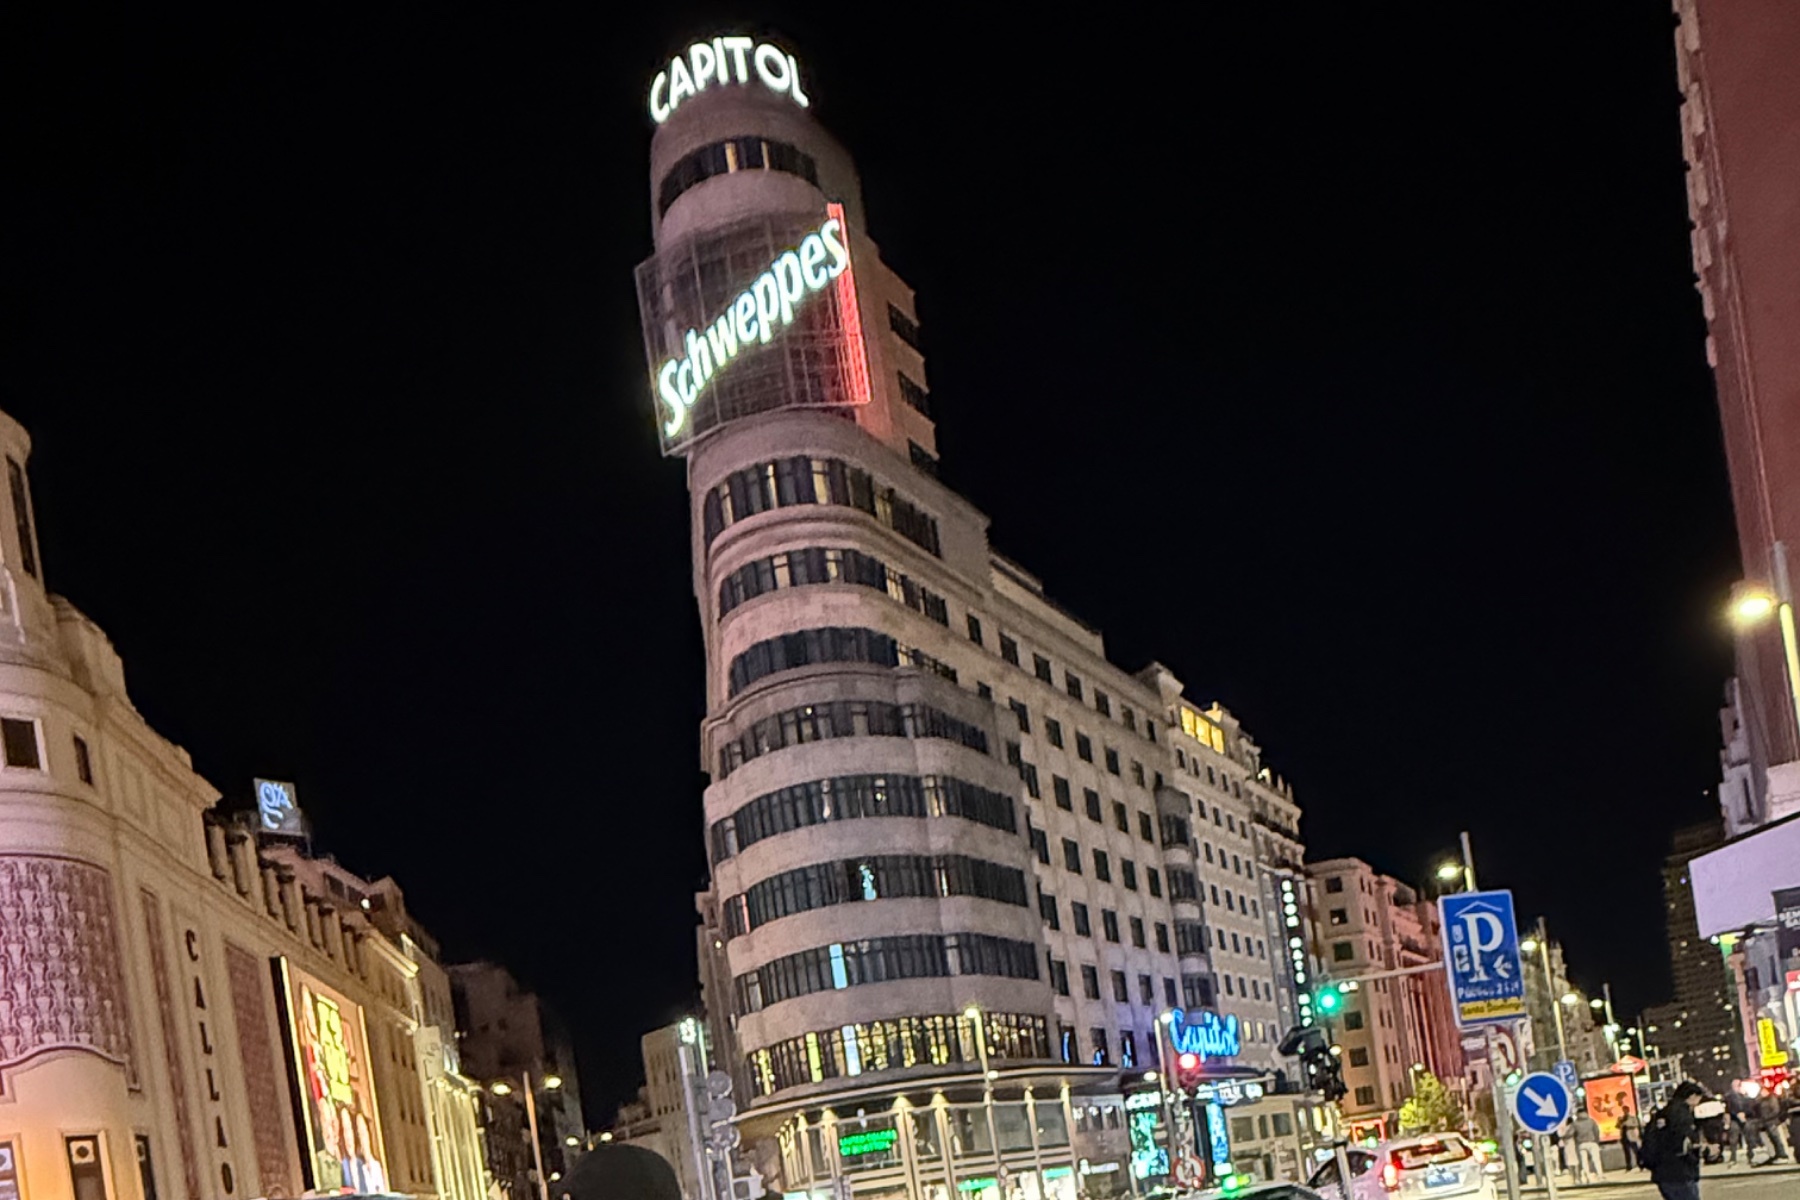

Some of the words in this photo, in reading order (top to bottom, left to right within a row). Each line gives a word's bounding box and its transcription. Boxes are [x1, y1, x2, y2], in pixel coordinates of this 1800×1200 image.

[649, 37, 809, 123] CAPITOL
[658, 219, 849, 437] Schweppes
[1459, 911, 1504, 982] P
[186, 929, 233, 1195] CALLAO
